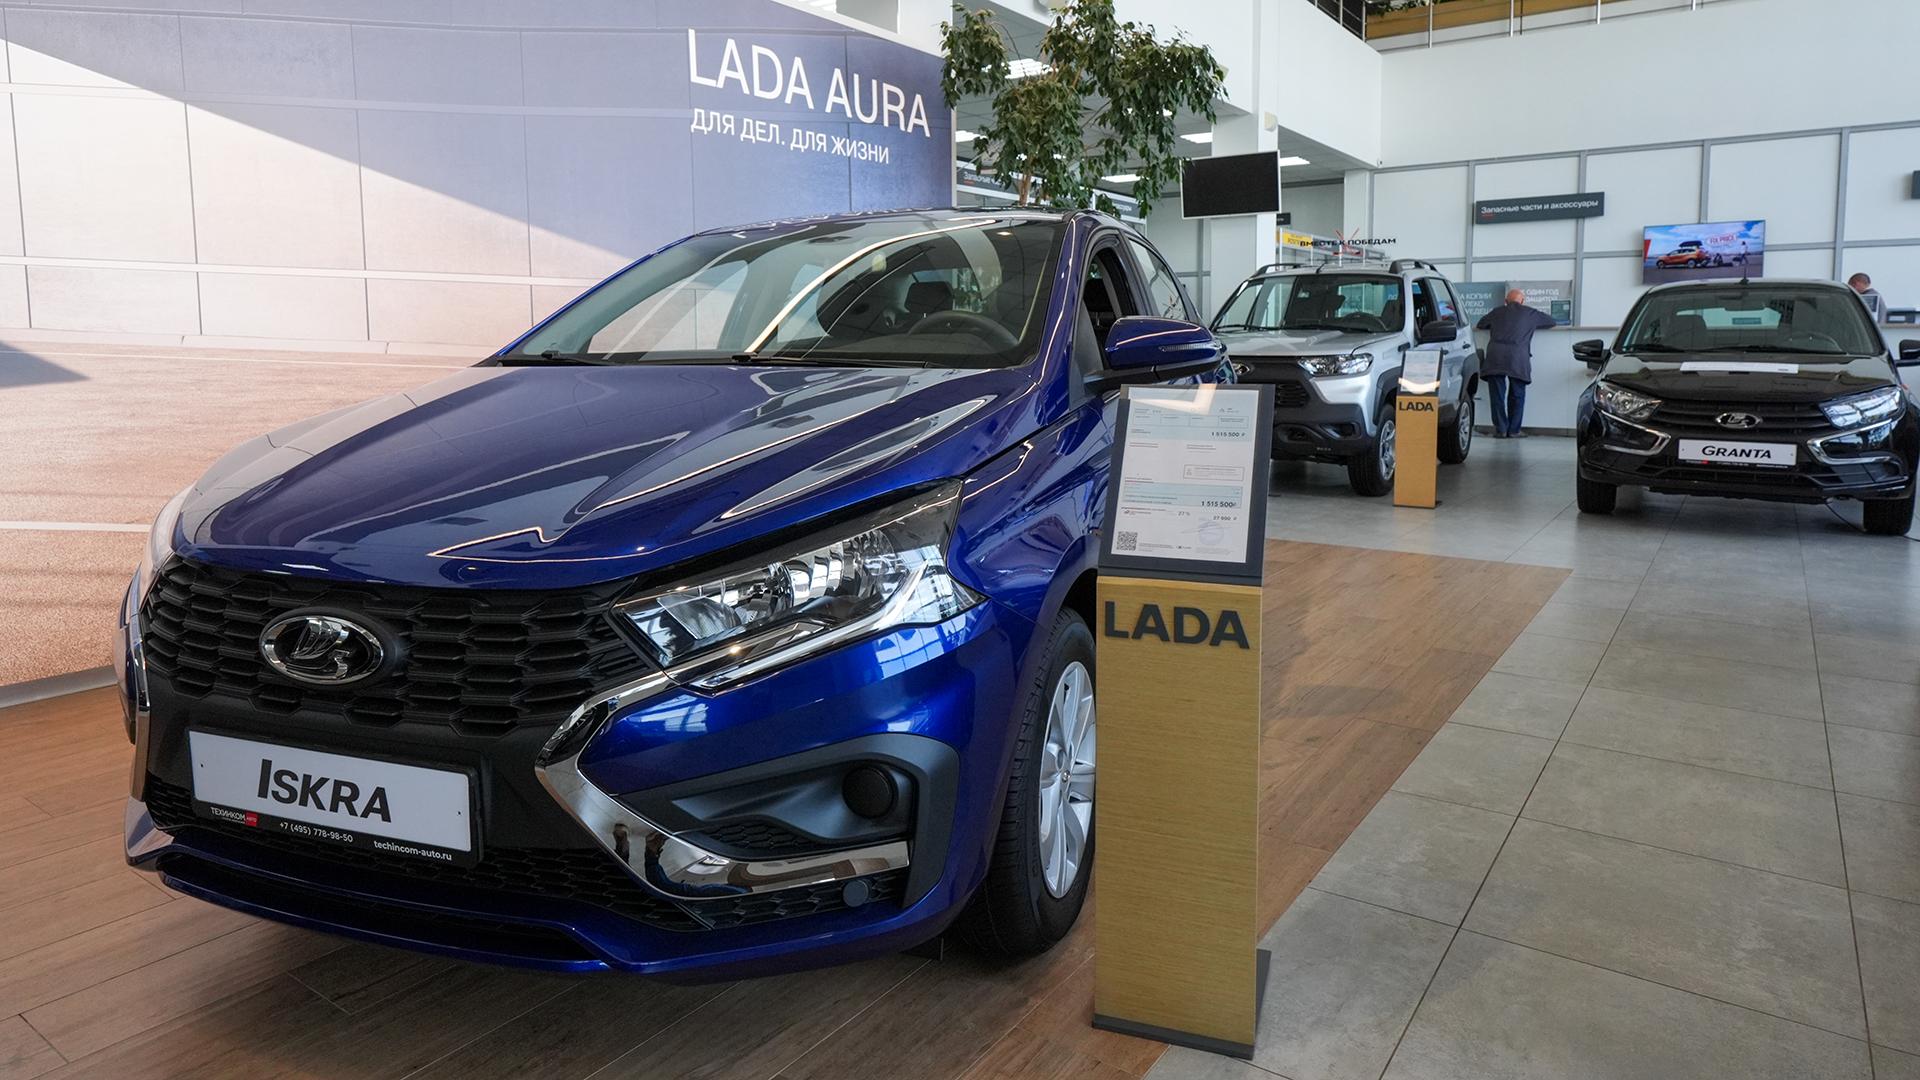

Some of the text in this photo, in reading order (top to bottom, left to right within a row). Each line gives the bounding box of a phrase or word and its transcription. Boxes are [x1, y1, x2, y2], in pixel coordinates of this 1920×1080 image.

[688, 28, 931, 137] LADA AURA
[691, 108, 889, 164] ДЛЯ ДЕЛ. ДЛЯ ЖИЗНИ
[1481, 206, 1520, 214] Запасные
[1550, 200, 1599, 210] аксессуары
[1347, 238, 1396, 246] ПОБЕДАМ
[1399, 401, 1434, 412] LADA
[1702, 445, 1771, 459] GRANTA
[1105, 601, 1250, 649] LADA
[257, 759, 392, 823] ISKRA
[279, 821, 353, 843] +7 (495) 778-98-50
[373, 840, 452, 861] techincom-auto.ru
